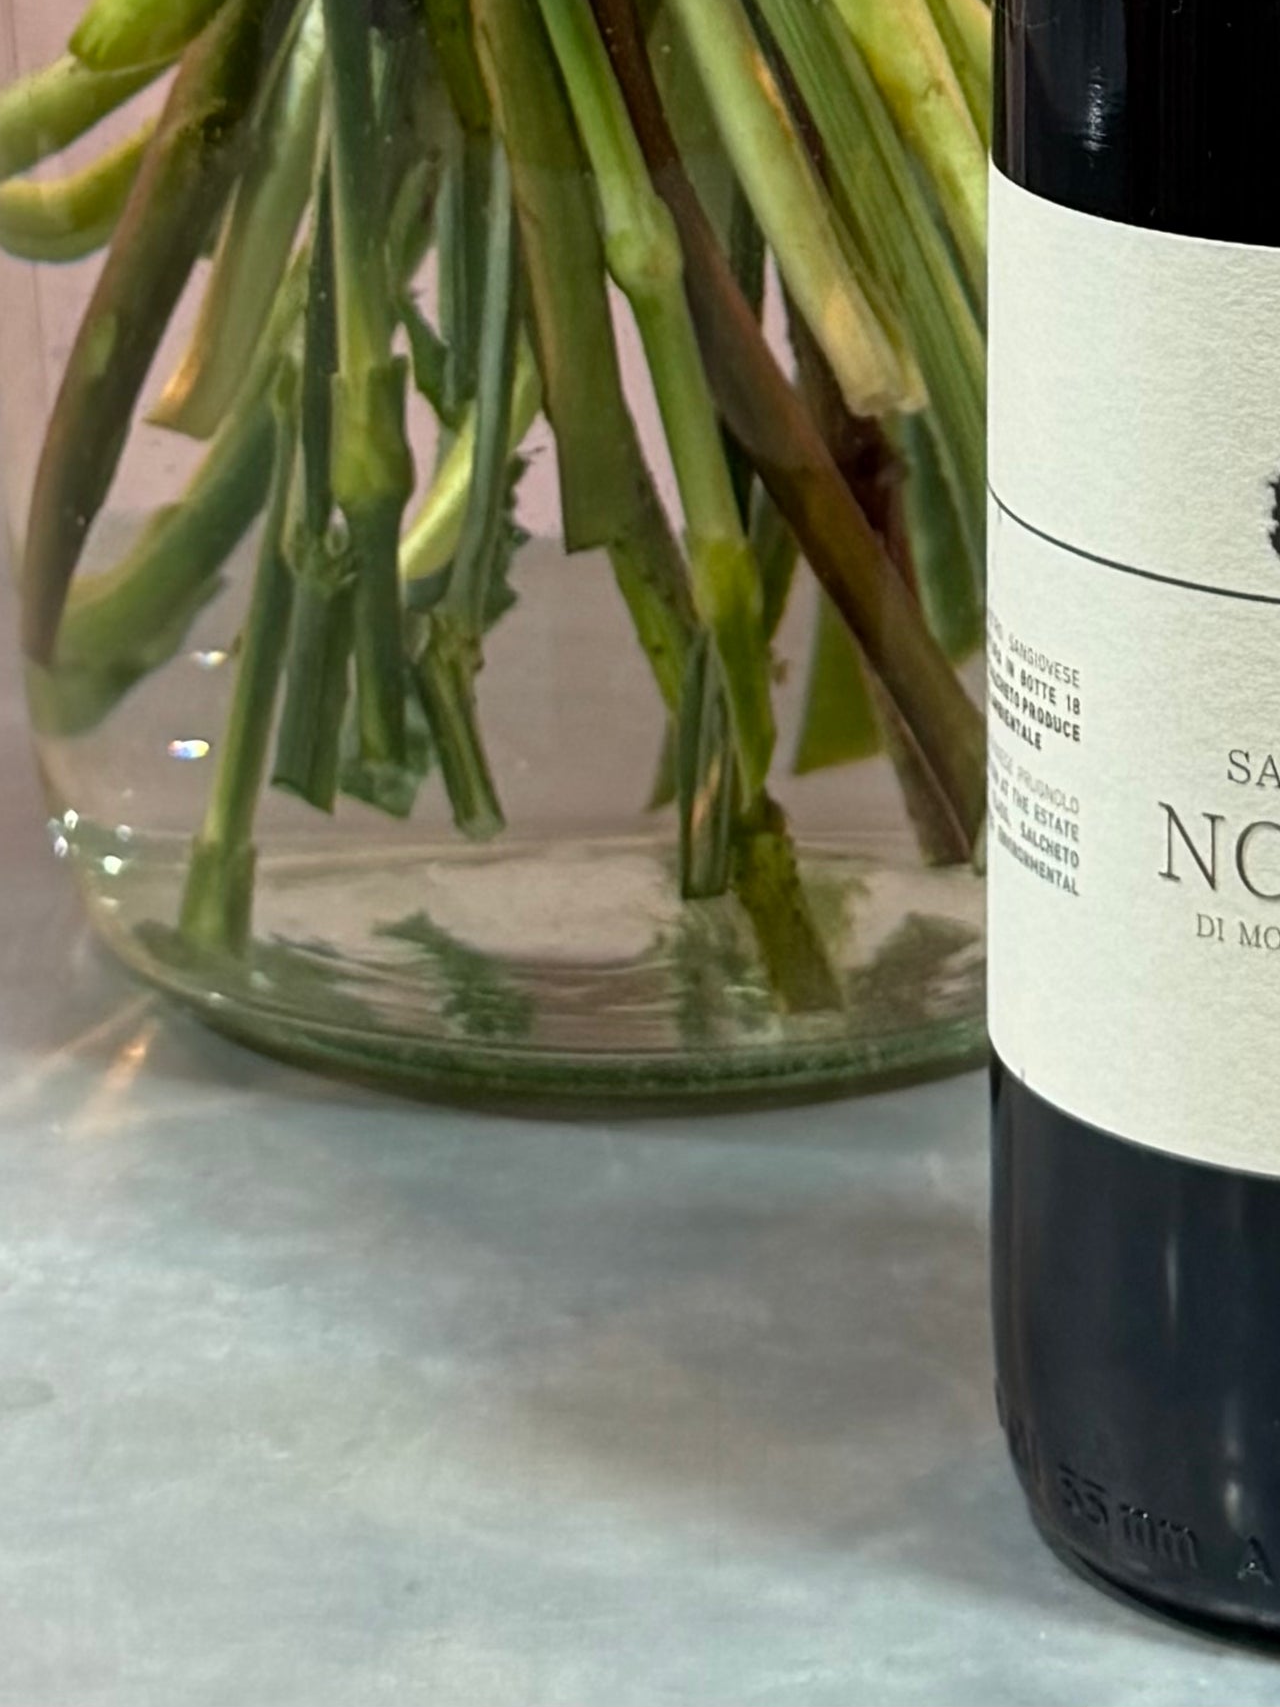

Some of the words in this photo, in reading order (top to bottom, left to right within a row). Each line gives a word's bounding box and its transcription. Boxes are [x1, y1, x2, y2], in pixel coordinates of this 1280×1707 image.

[1008, 632, 1080, 689] SANGIOVESE
[1021, 669, 1056, 705] BOTTE
[1067, 694, 1081, 716] 18
[1022, 697, 1081, 742] PRODUCE
[1020, 820, 1080, 869] SALCHETO
[1034, 803, 1079, 842] ESTATE
[1196, 913, 1225, 942] DI
[1235, 1535, 1275, 1587] A
